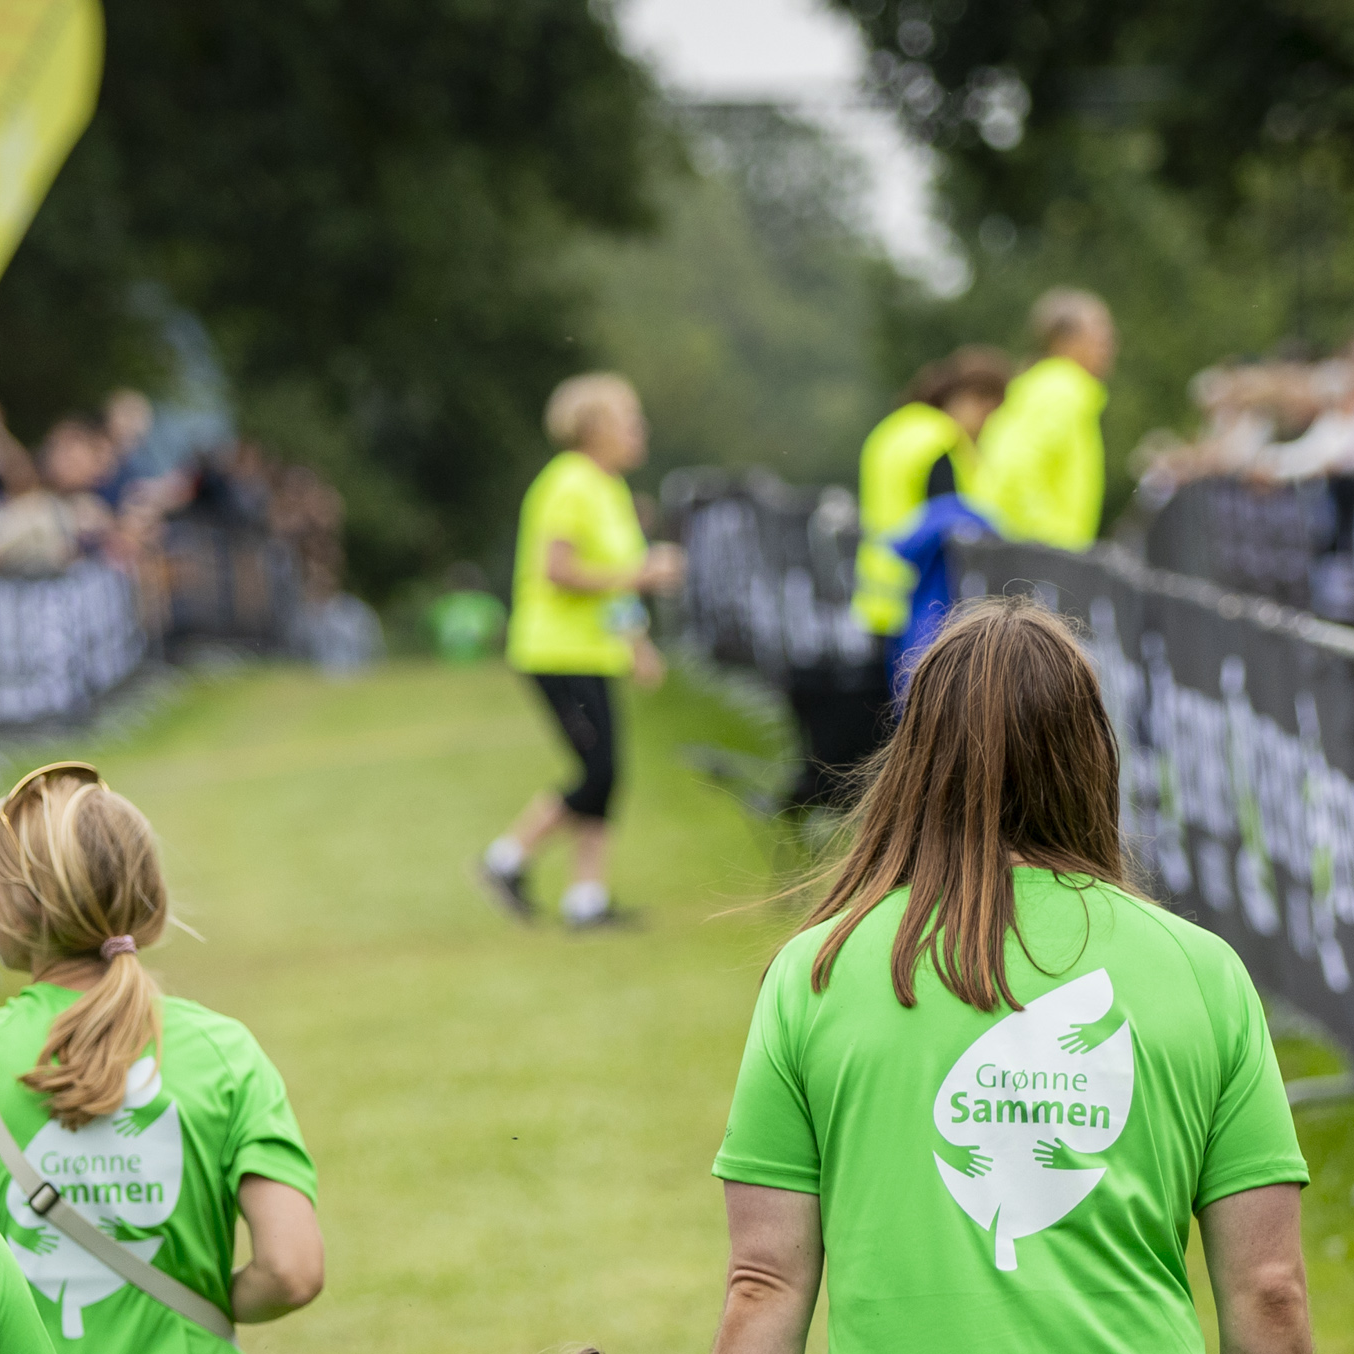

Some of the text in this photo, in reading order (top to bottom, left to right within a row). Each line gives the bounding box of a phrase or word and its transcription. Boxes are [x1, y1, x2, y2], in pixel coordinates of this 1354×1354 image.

[975, 1063, 1088, 1092] Grønne
[950, 1091, 1111, 1130] Sammen
[40, 1150, 142, 1176] Grønne
[52, 1181, 164, 1204] mmen
